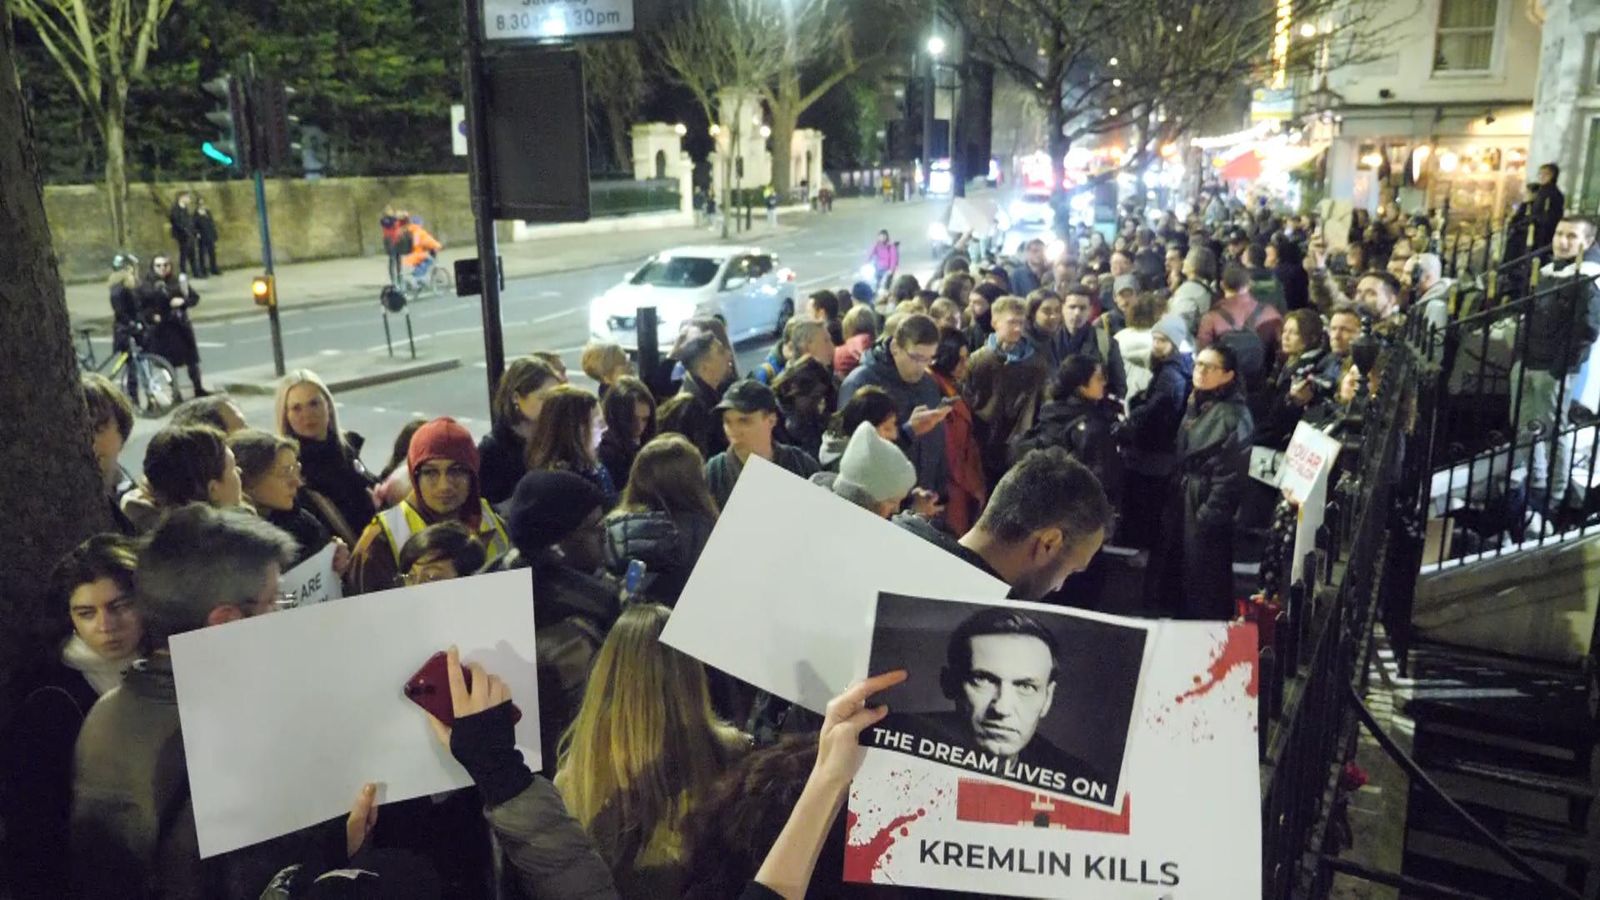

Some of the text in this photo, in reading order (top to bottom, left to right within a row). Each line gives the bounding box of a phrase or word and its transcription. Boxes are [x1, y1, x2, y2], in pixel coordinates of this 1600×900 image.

[300, 572, 322, 601] ARE
[873, 727, 1107, 801] THE DREAM LIVES ON
[919, 839, 1180, 887] KREMLIN KILLS
